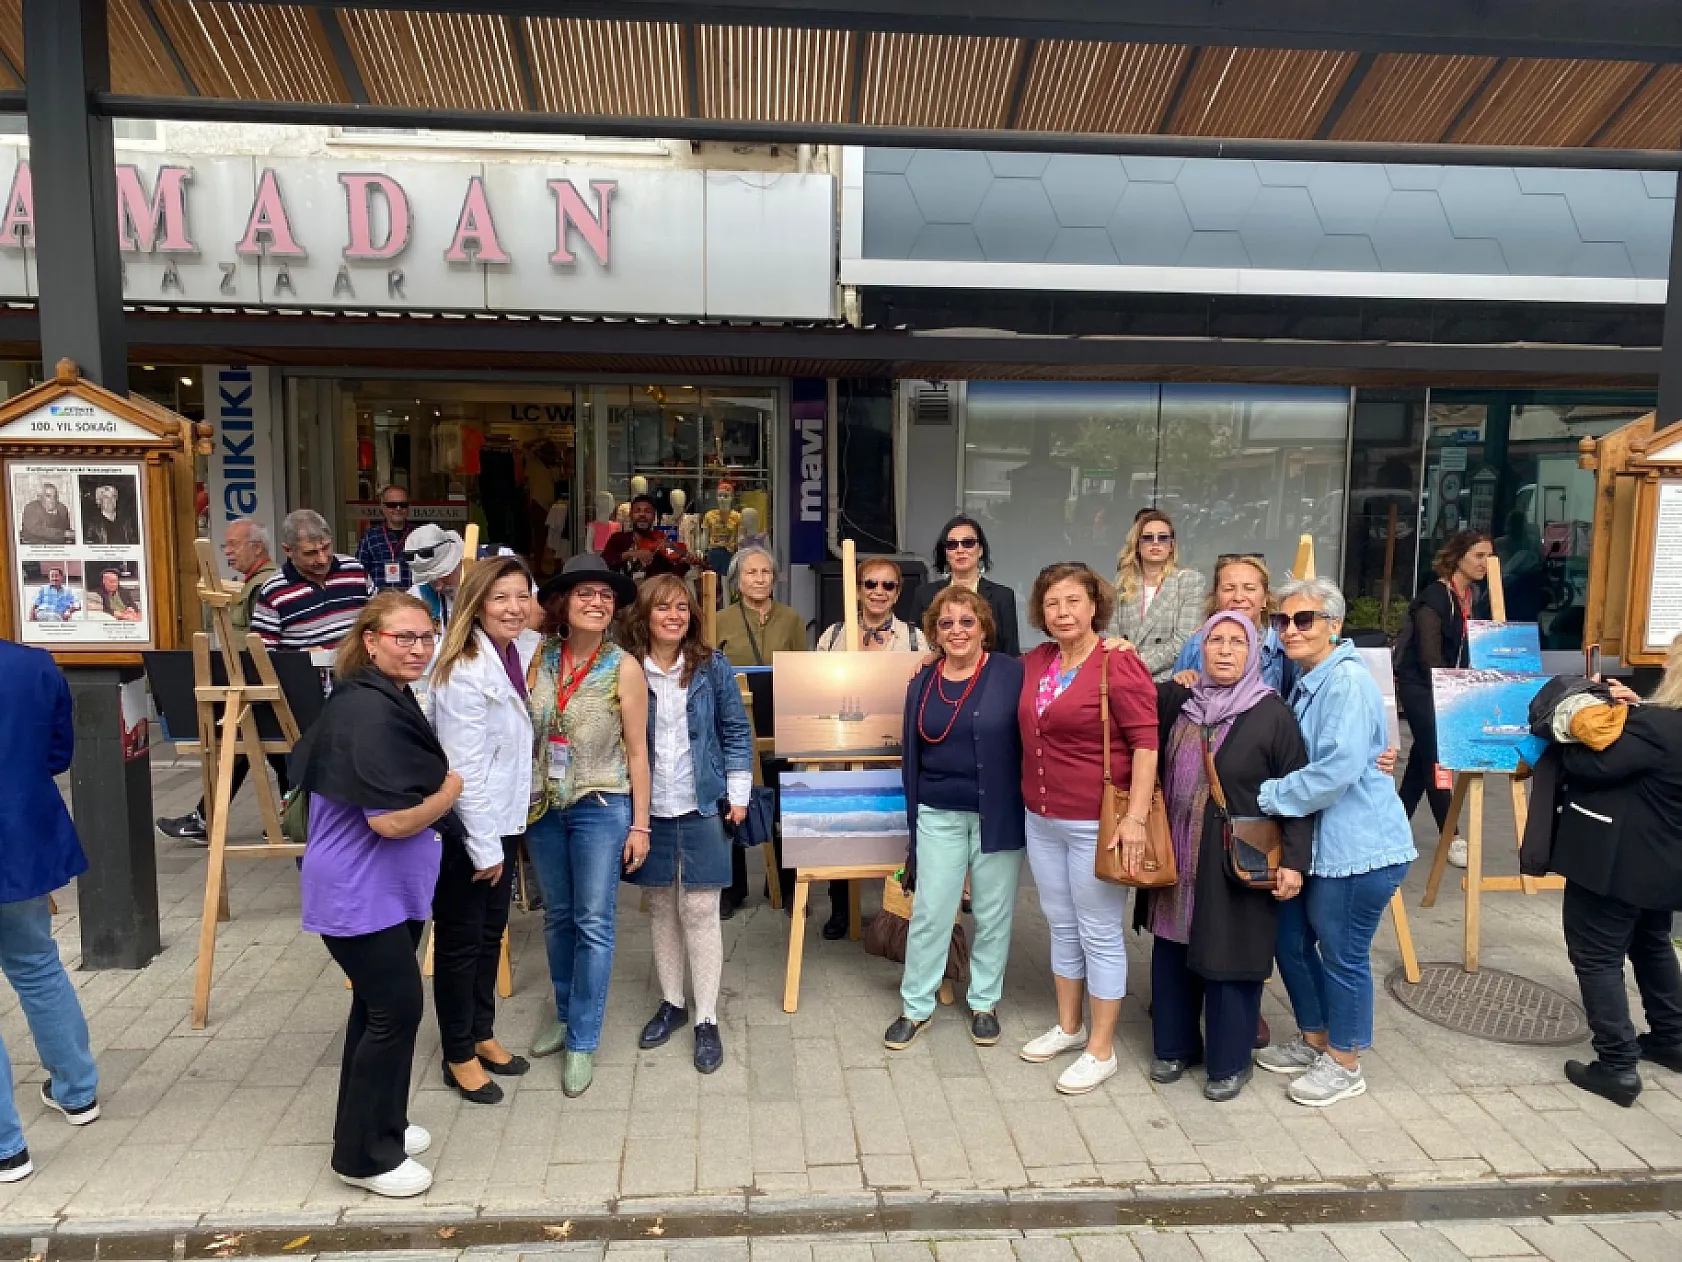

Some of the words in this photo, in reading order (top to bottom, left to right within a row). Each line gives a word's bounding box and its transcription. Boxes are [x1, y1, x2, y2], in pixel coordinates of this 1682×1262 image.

[121, 261, 407, 299] AZAAR
[30, 422, 54, 432] 100.
[794, 418, 823, 522] mavi
